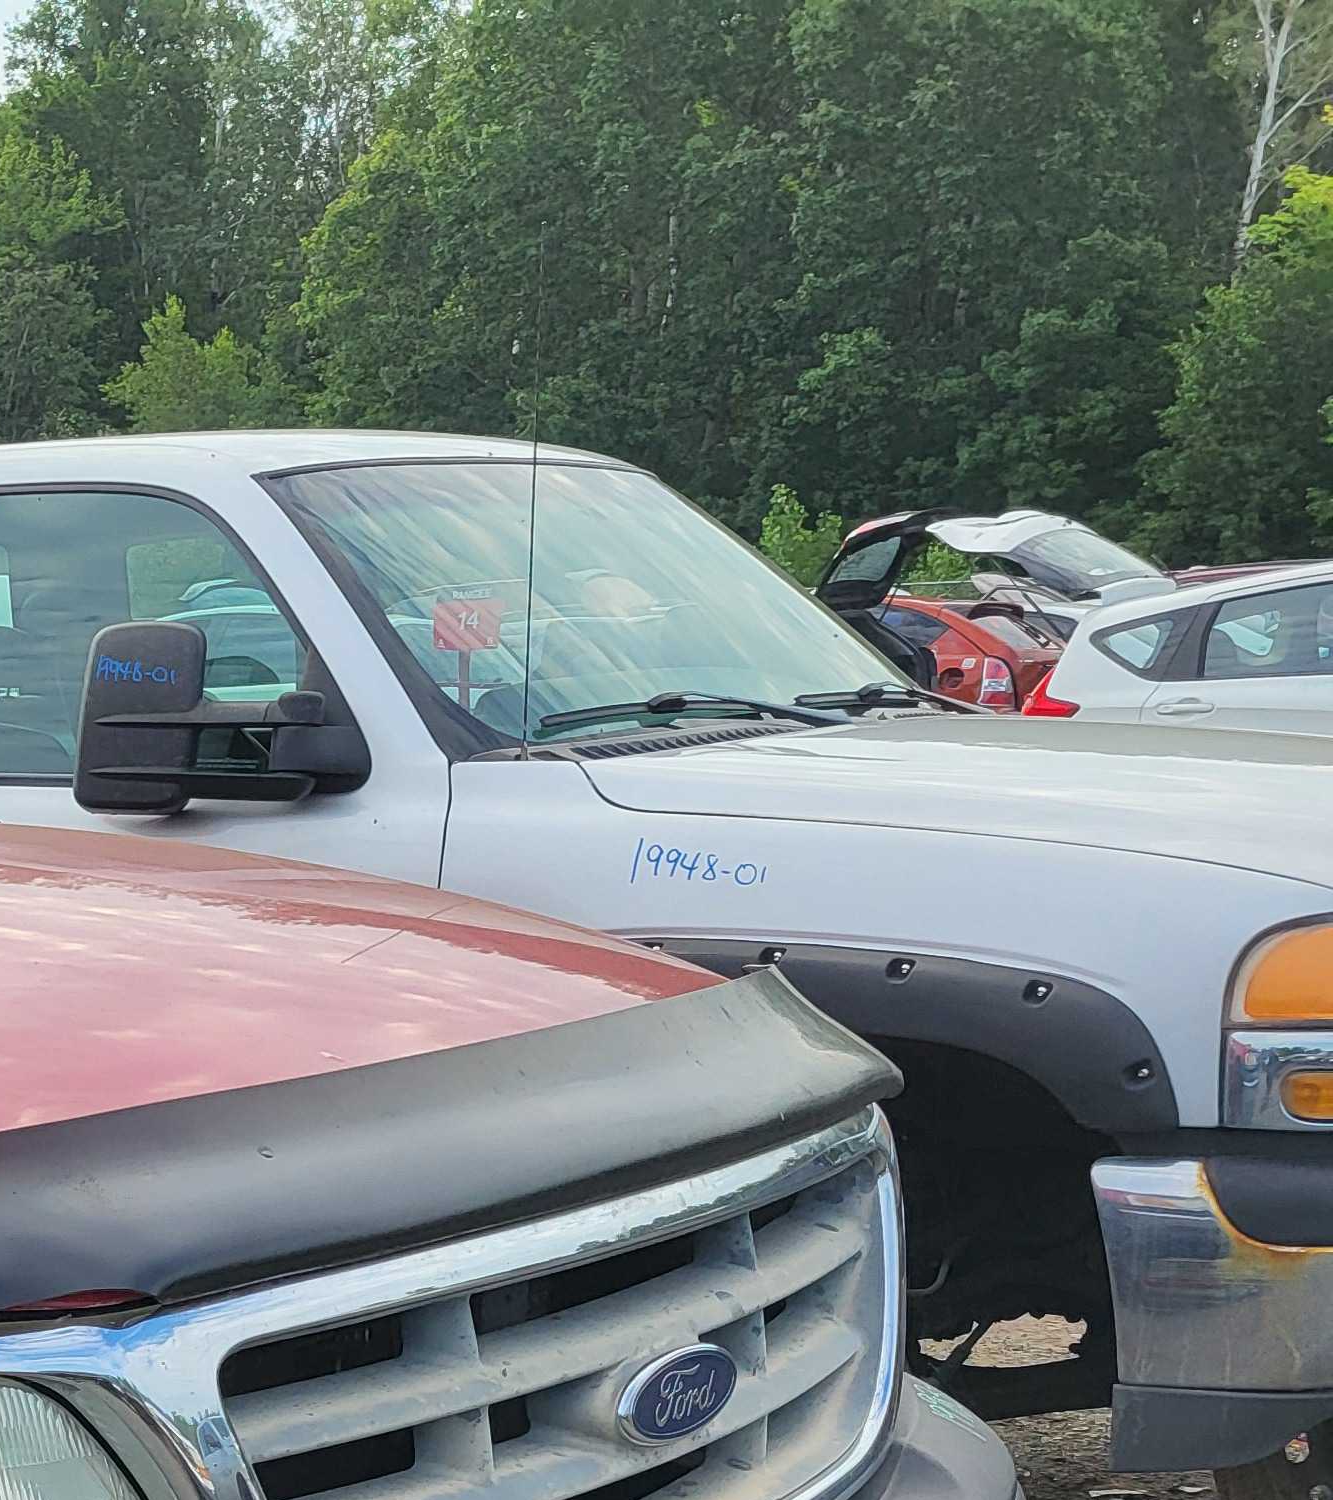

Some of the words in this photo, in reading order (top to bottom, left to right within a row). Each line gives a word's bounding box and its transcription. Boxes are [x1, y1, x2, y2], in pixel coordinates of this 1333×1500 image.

[458, 608, 480, 631] 14
[630, 837, 768, 886] 19948-01
[655, 1363, 717, 1427] Ford
